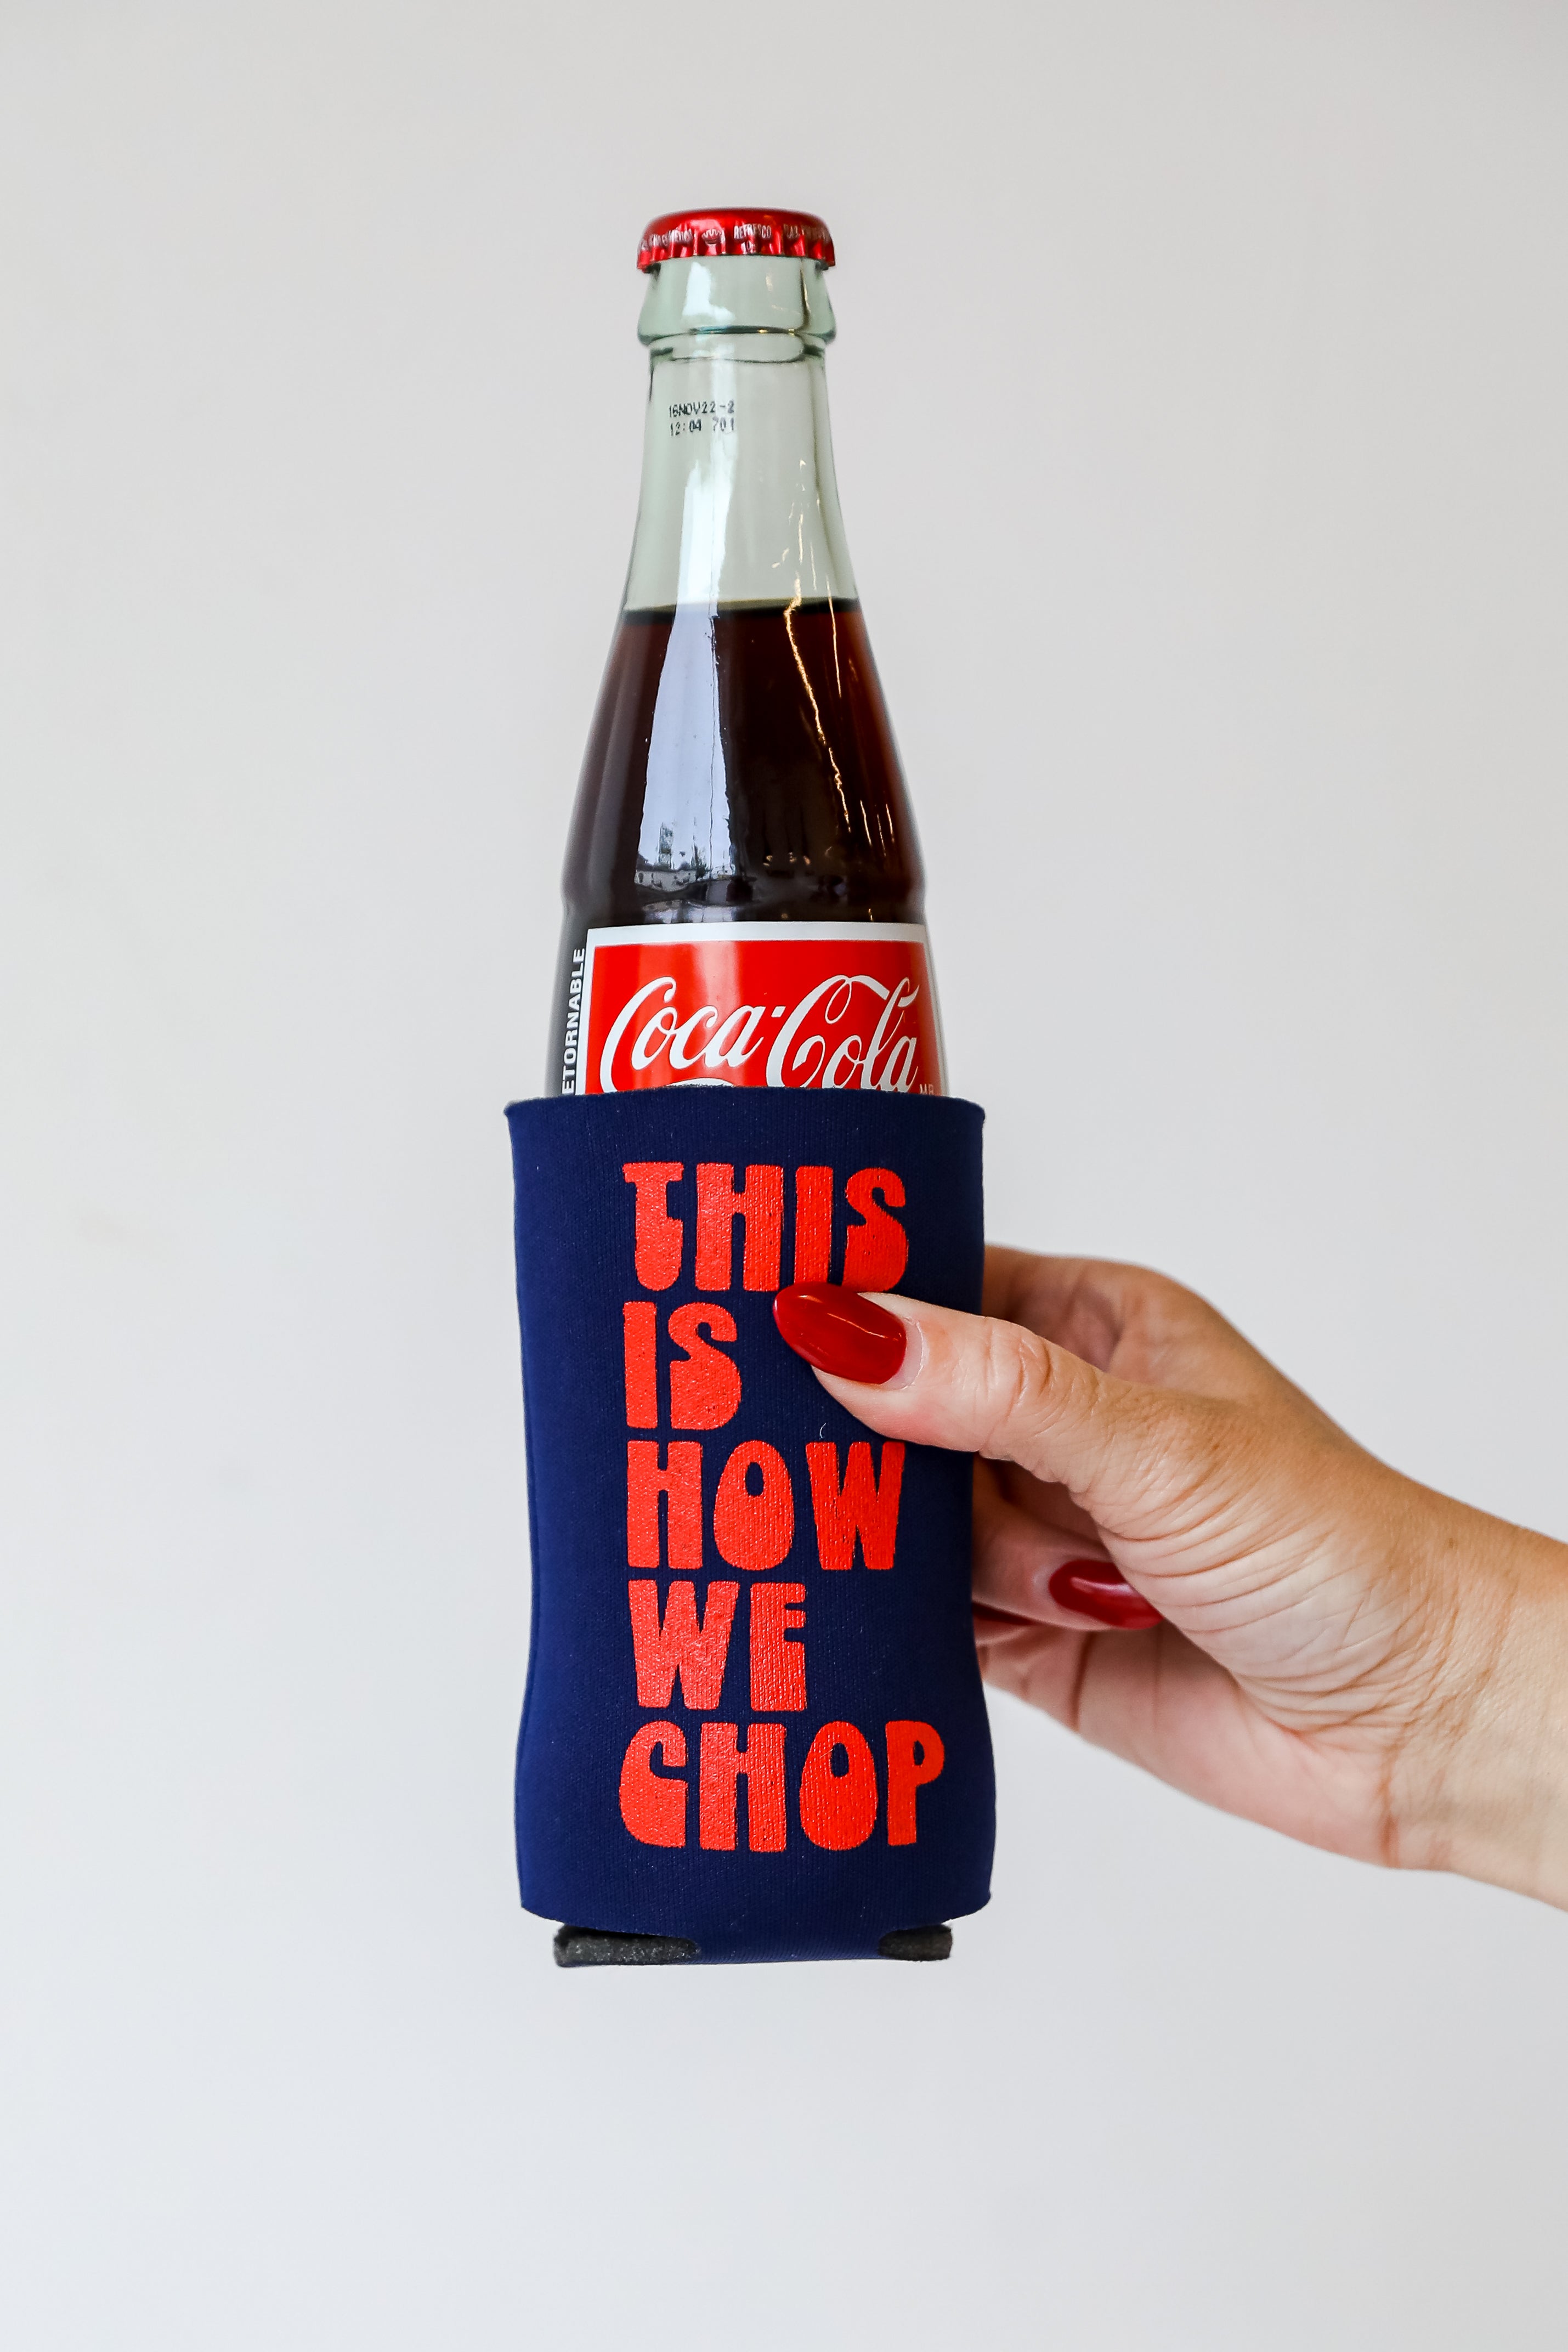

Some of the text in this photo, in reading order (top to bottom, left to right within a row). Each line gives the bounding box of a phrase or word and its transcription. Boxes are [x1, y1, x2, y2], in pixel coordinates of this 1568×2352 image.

[734, 223, 771, 239] REFRESCO
[600, 975, 920, 1093] Coca-Cola
[622, 1162, 909, 1296] THIS
[623, 1302, 741, 1430] IS
[627, 1440, 905, 1570] HOW
[628, 1579, 807, 1711] WE
[619, 1720, 944, 1852] CHOP
